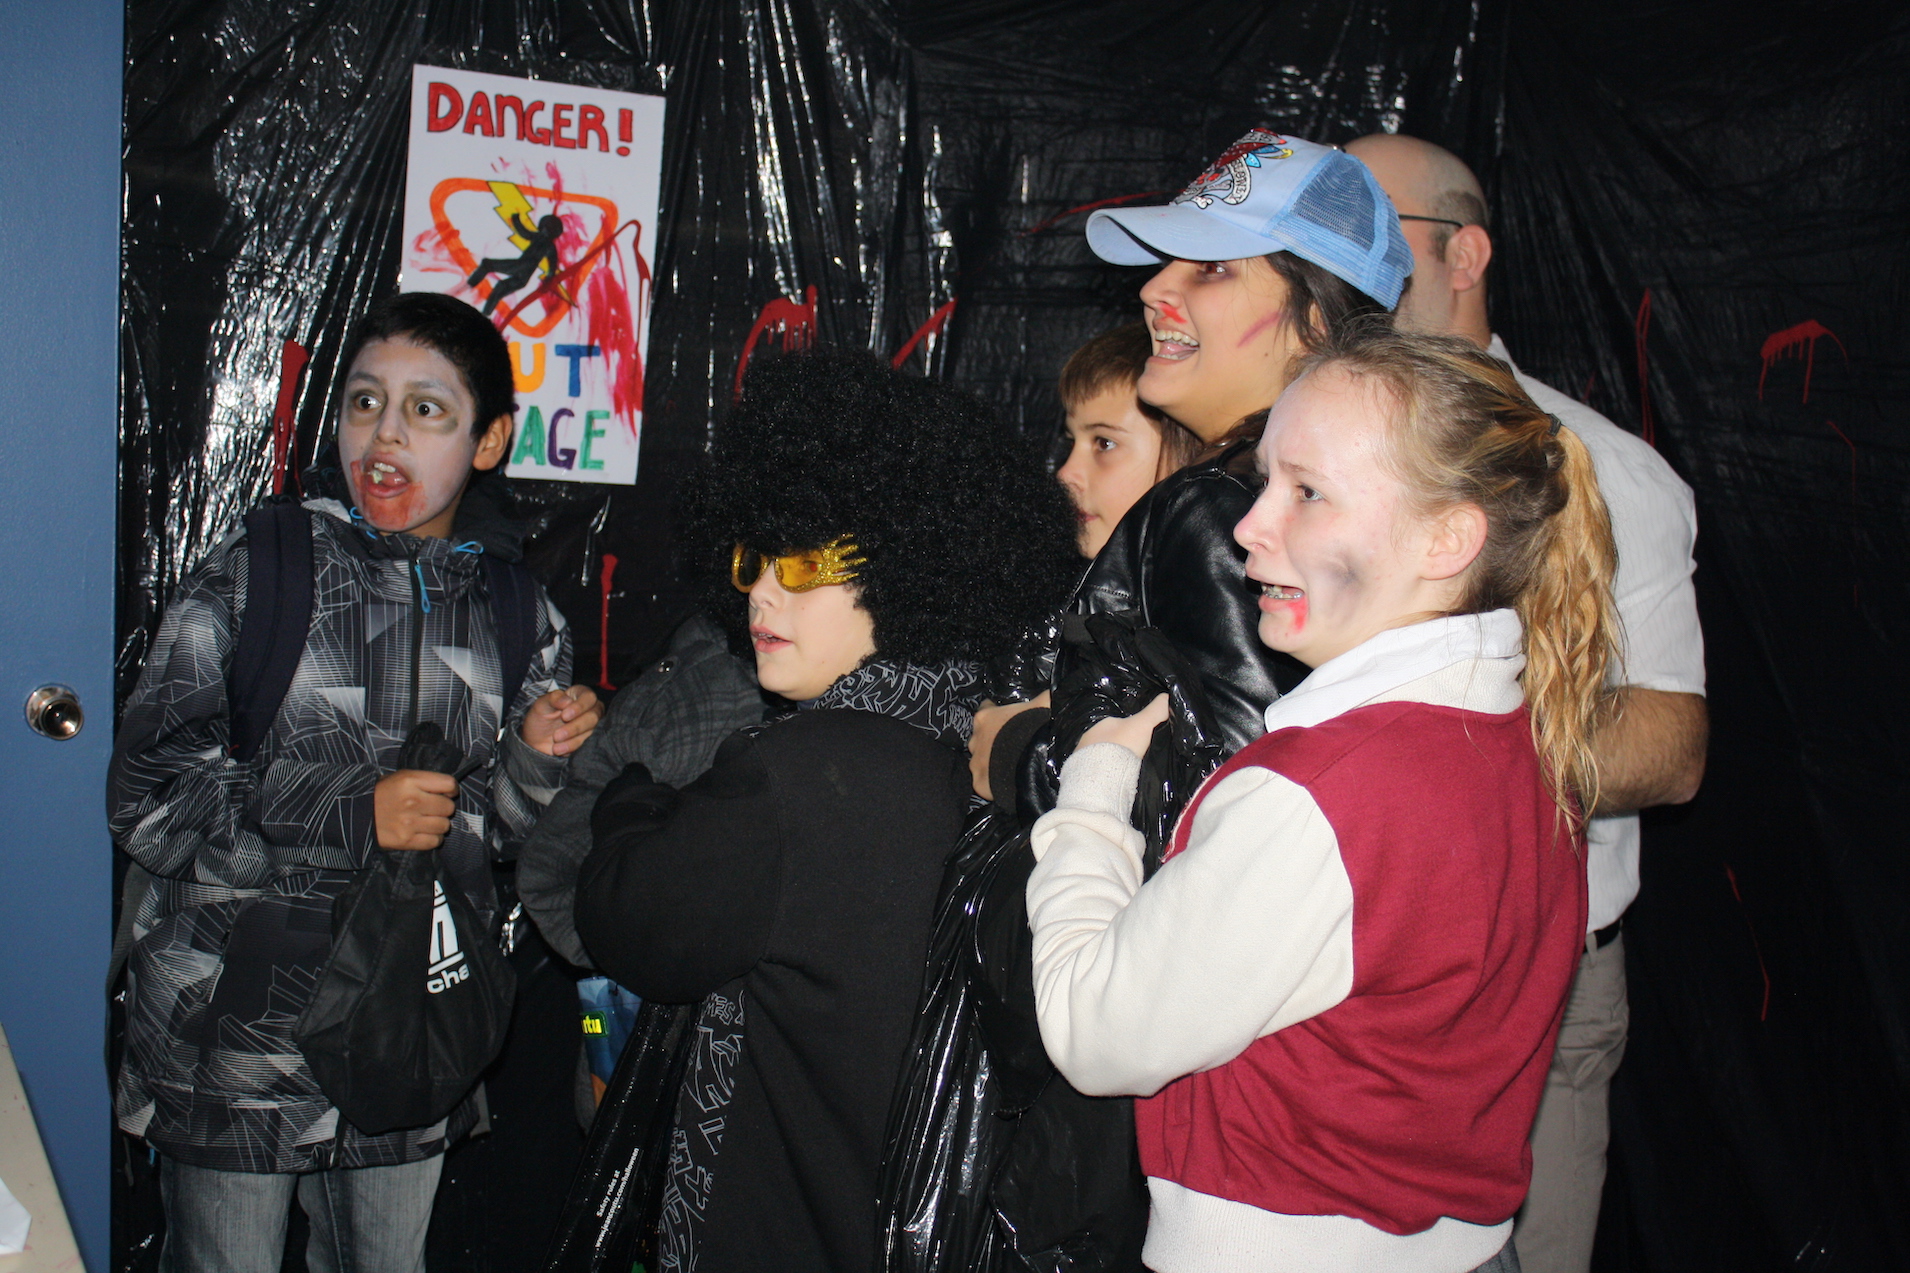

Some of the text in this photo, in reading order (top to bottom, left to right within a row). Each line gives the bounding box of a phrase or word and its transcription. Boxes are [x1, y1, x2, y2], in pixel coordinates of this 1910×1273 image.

[511, 403, 610, 470] AGE
[596, 1196, 610, 1218] Safety
[607, 1178, 617, 1196] rules
